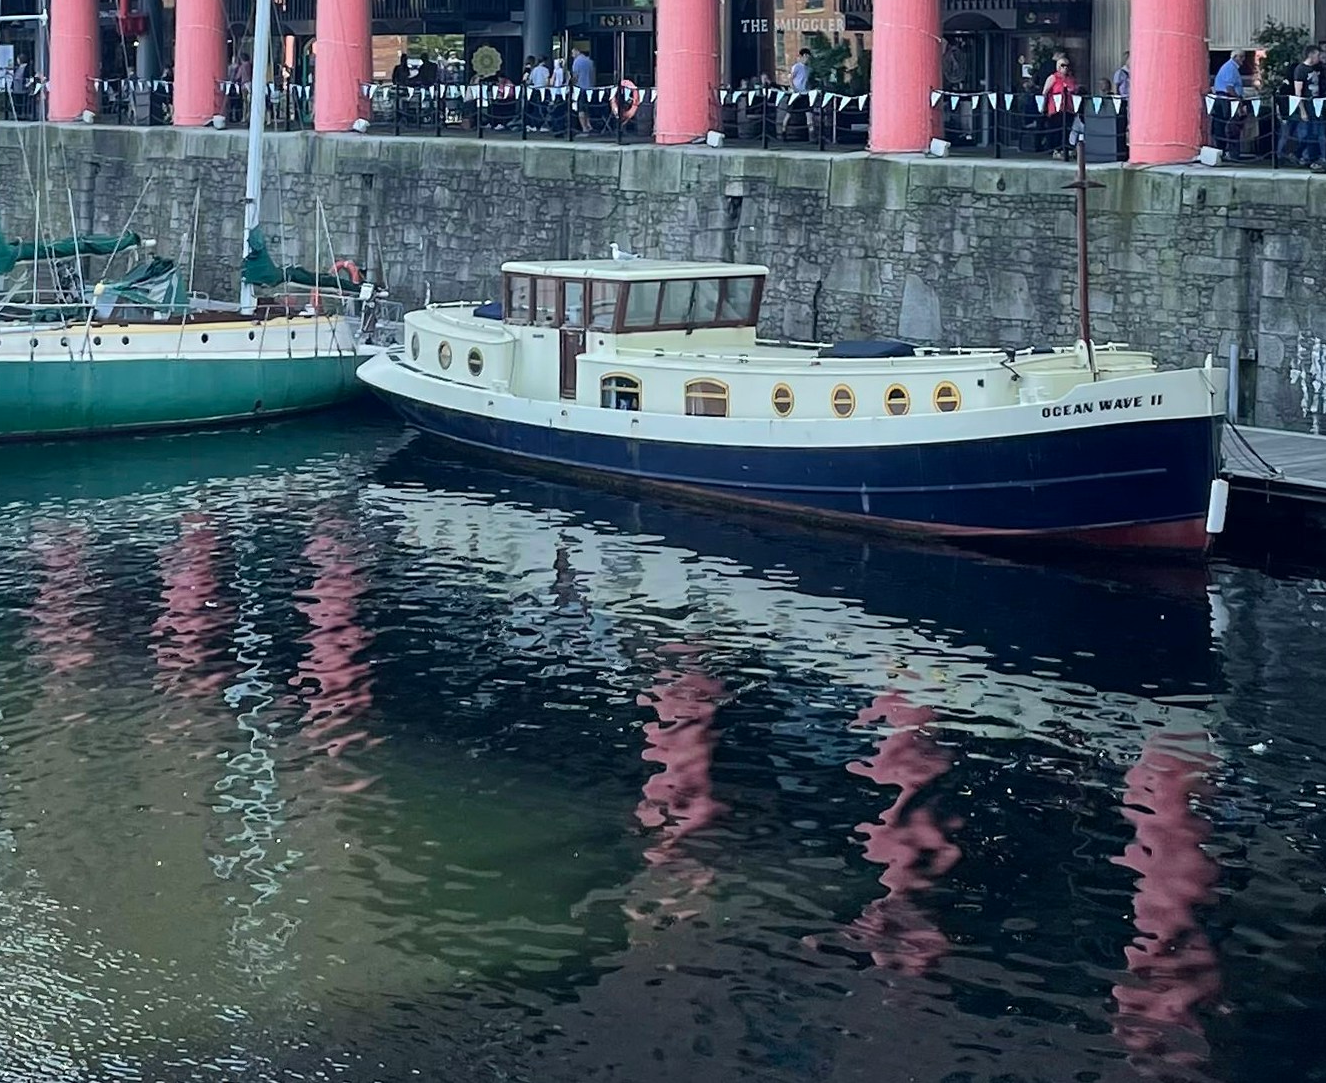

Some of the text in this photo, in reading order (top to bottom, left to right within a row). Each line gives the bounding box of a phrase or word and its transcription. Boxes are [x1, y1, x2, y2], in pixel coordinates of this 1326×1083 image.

[741, 18, 845, 33] THE SMUGGLER
[1041, 402, 1094, 418] OCEAN
[1098, 396, 1143, 411] WAVE
